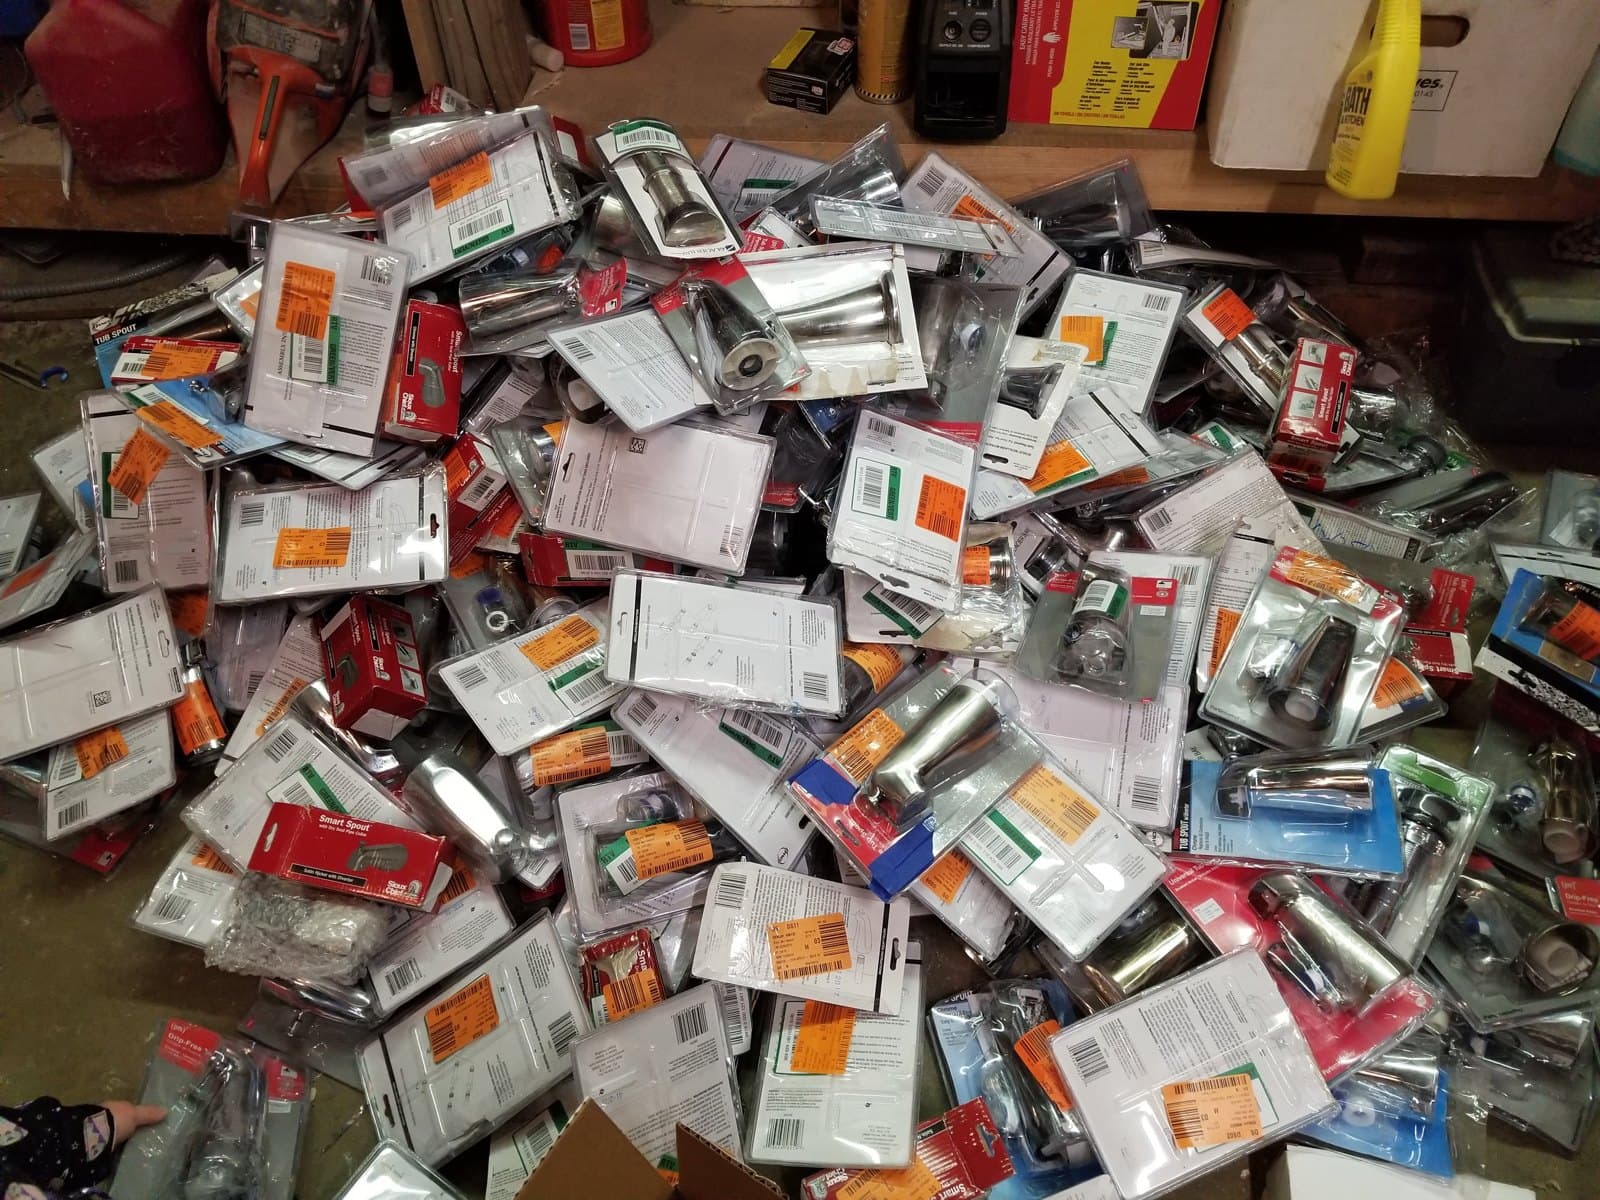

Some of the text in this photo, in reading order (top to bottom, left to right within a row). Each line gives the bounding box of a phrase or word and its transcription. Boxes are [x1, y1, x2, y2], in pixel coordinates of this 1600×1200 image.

[1343, 86, 1372, 115] BATH
[95, 332, 111, 345] TUB
[111, 323, 138, 339] SPOUT
[406, 393, 414, 410] Sioux
[1322, 387, 1330, 402] Spout
[1318, 403, 1327, 418] Smart
[319, 814, 370, 832] Smart Spout
[1180, 819, 1190, 837] SPOUT
[1180, 837, 1189, 849] TUB
[387, 880, 407, 890] Sioux
[1168, 867, 1195, 886] Universal
[386, 887, 404, 896] Chief
[167, 1033, 202, 1051] Drip-Free
[824, 1172, 849, 1188] Sioux
[937, 1182, 966, 1200] Smart
